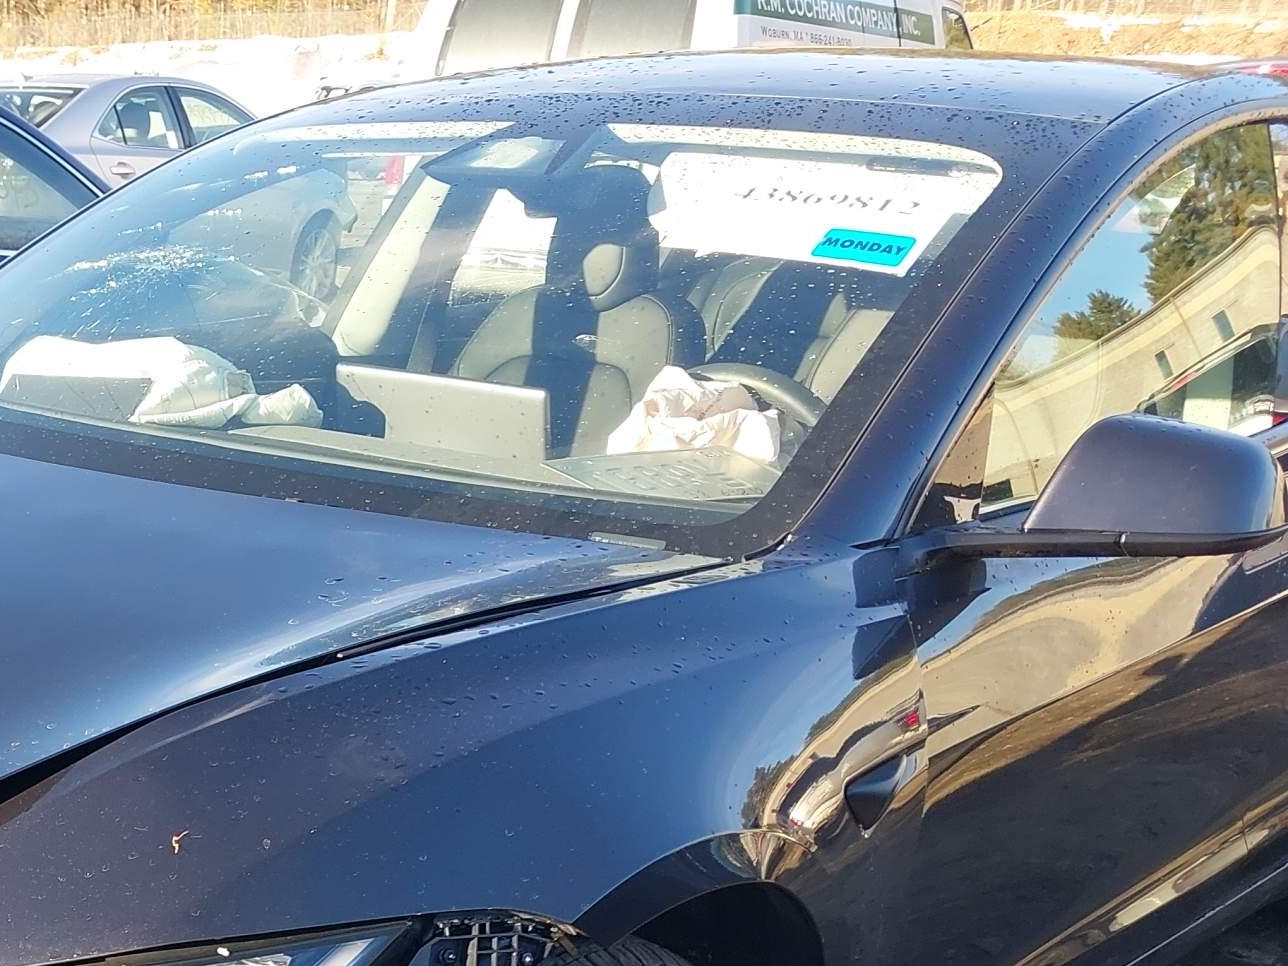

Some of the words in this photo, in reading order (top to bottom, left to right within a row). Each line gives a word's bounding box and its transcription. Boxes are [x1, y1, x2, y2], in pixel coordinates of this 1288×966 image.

[787, 0, 846, 24] COCHRAN
[902, 14, 921, 36] INC.
[820, 235, 906, 257] MONDAY
